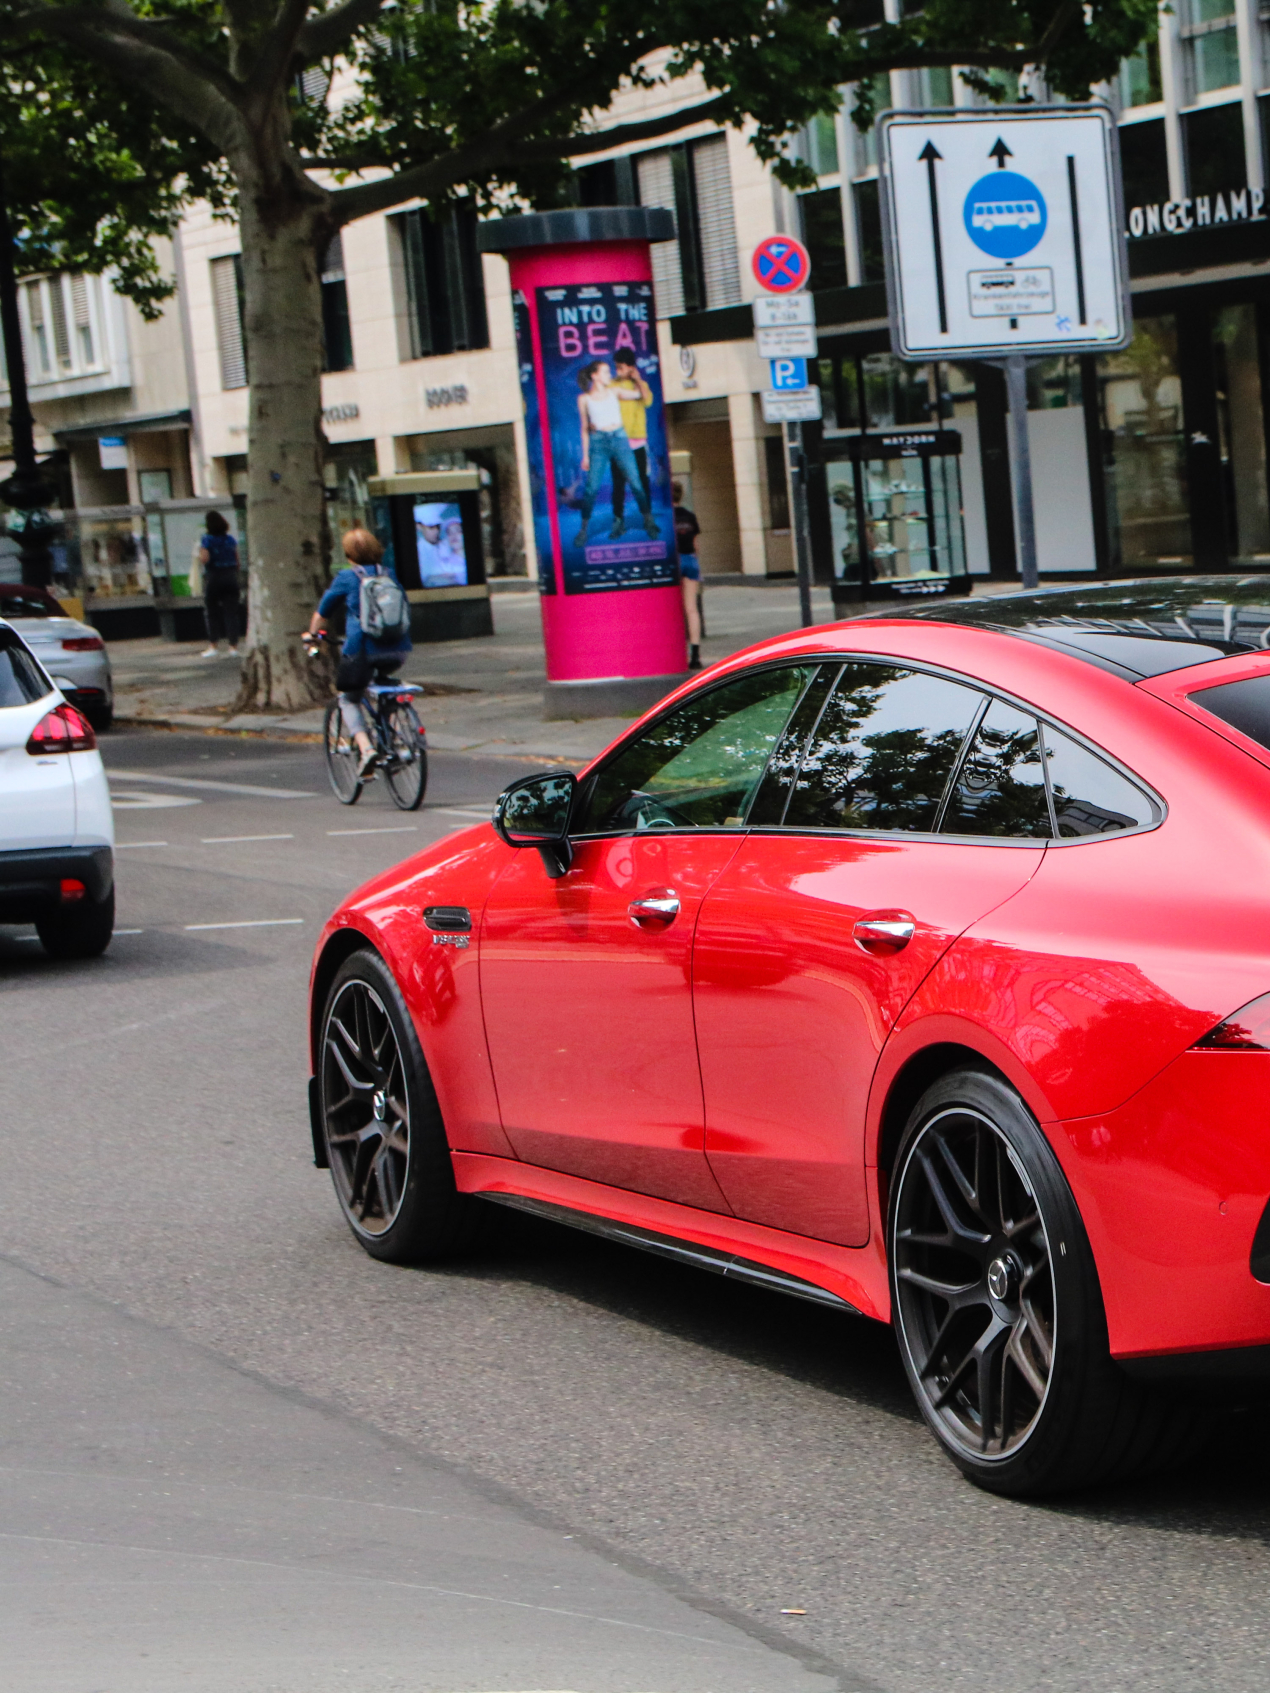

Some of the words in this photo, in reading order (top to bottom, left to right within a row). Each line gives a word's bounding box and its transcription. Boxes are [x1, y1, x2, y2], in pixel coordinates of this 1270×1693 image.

[1123, 187, 1265, 239] ONGCHAMP
[556, 305, 606, 325] INTO
[617, 302, 649, 321] THE
[558, 321, 650, 358] BEAT
[774, 360, 795, 387] P
